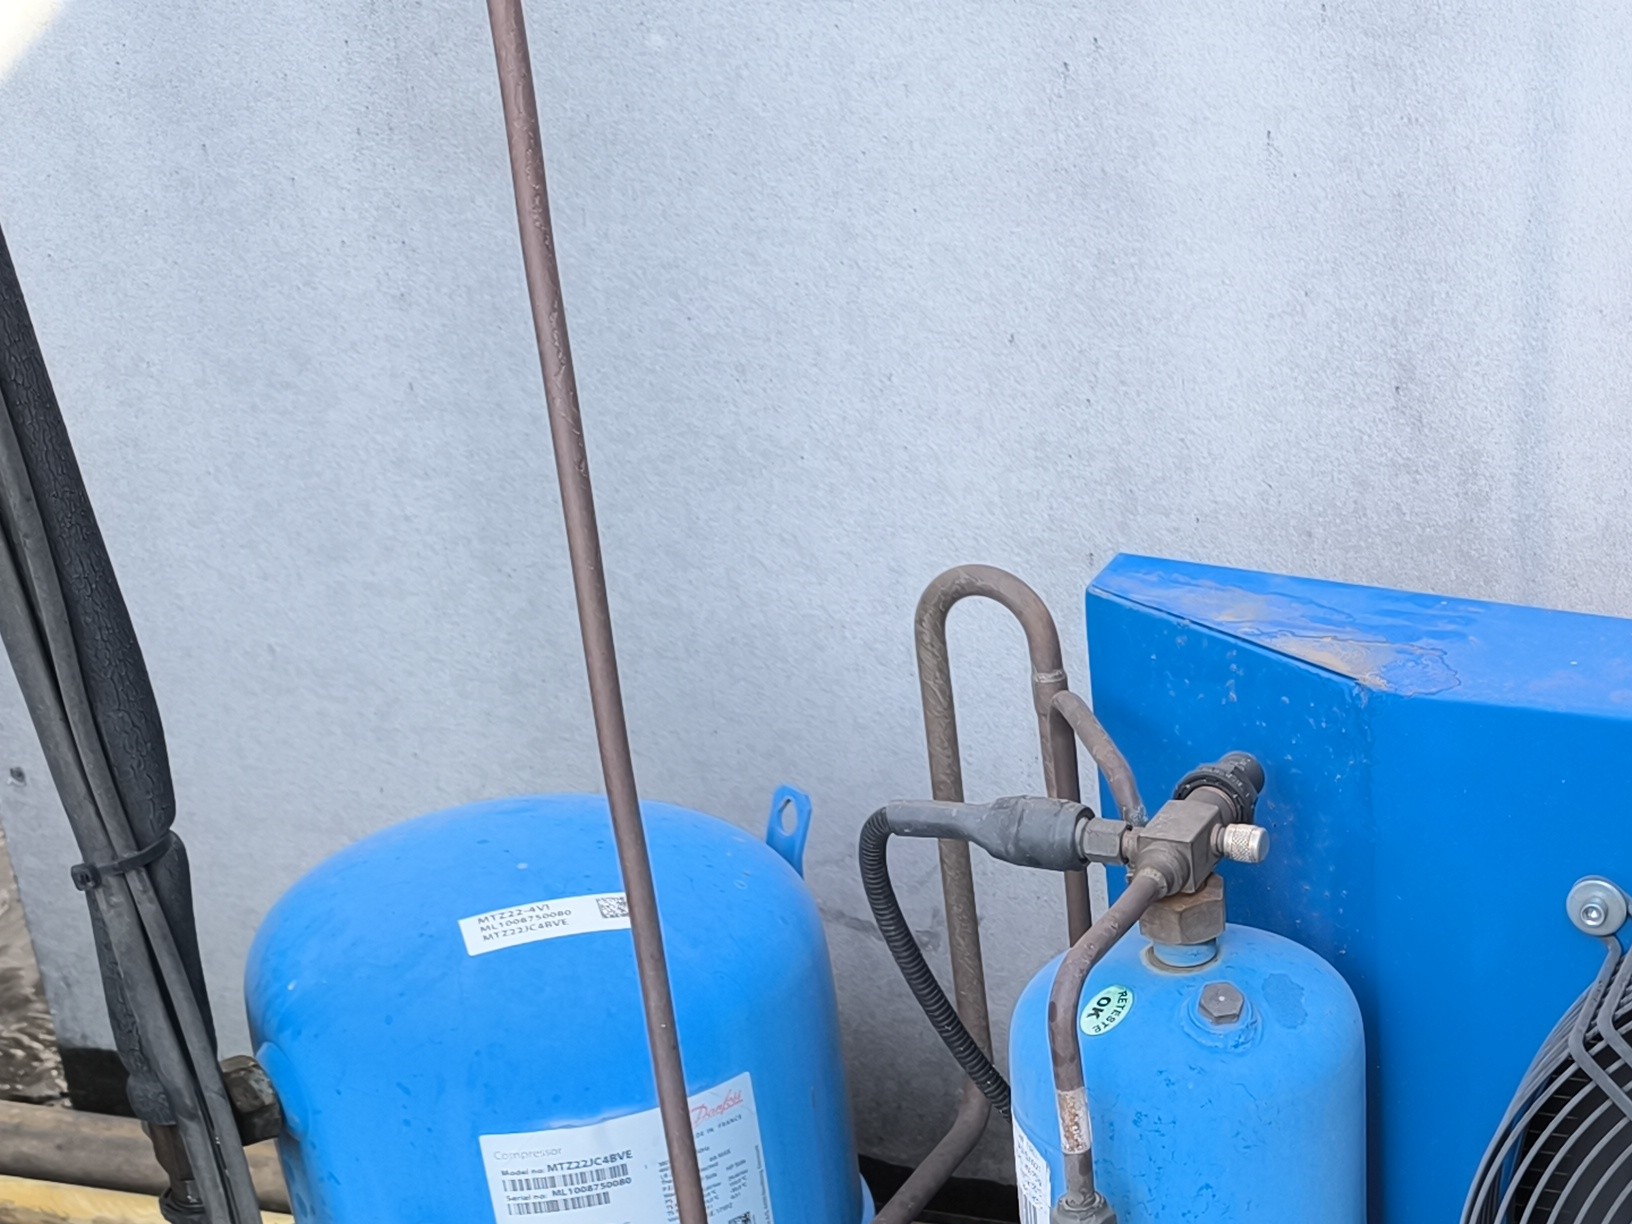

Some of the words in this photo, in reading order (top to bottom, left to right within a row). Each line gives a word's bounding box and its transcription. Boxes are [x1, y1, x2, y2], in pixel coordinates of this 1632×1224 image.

[1086, 996, 1111, 1019] OK
[493, 1147, 562, 1161] Compressor
[501, 1168, 529, 1177] Model
[547, 1149, 633, 1173] MTZ22JC4BVE
[506, 1193, 531, 1202] Serial
[552, 1176, 632, 1198] ML1008750080
